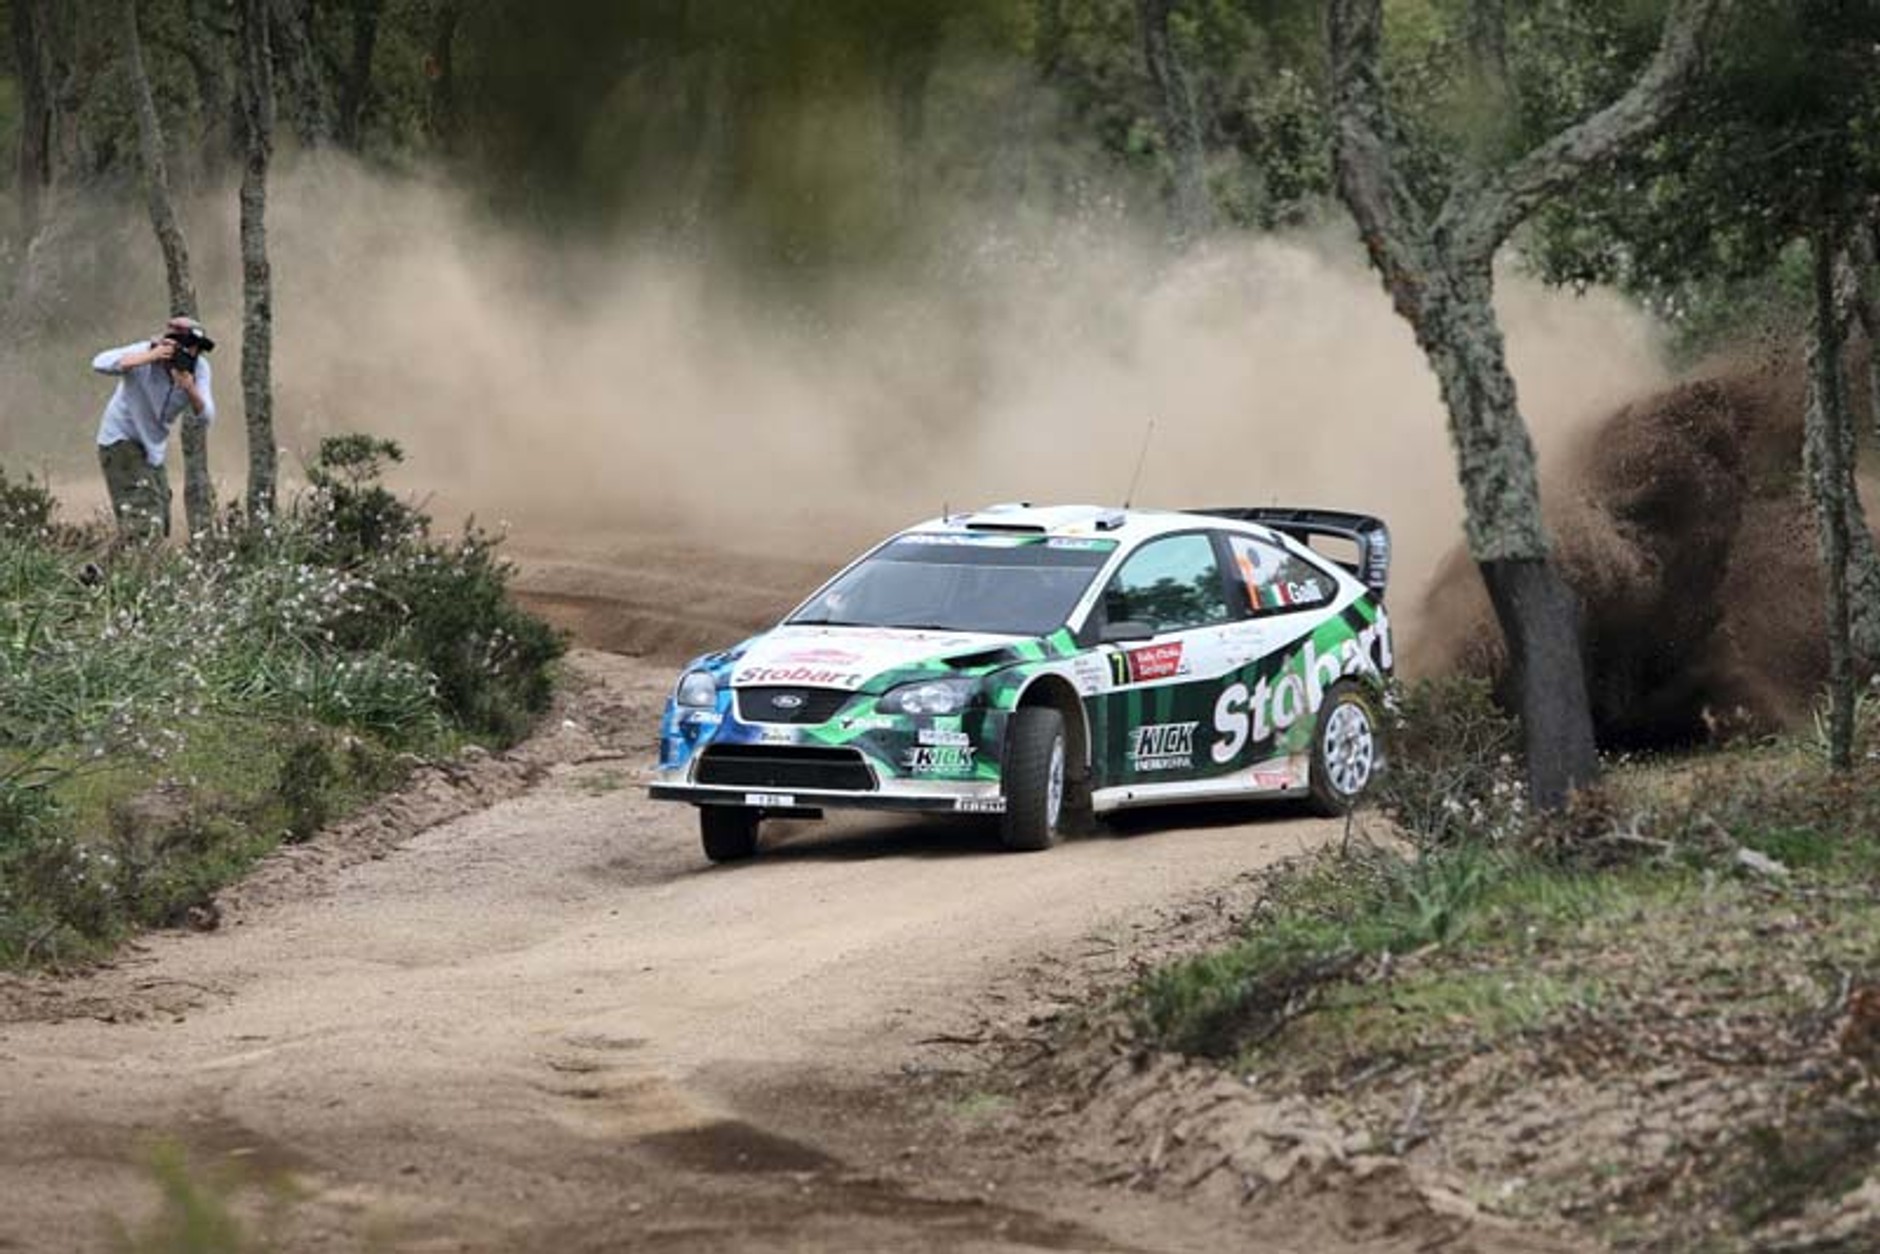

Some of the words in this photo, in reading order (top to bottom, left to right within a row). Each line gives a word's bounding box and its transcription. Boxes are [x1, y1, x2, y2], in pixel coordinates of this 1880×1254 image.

[735, 666, 862, 686] Stobart
[1111, 654, 1125, 684] 7
[1136, 722, 1198, 757] KICK
[912, 747, 976, 766] KICK
